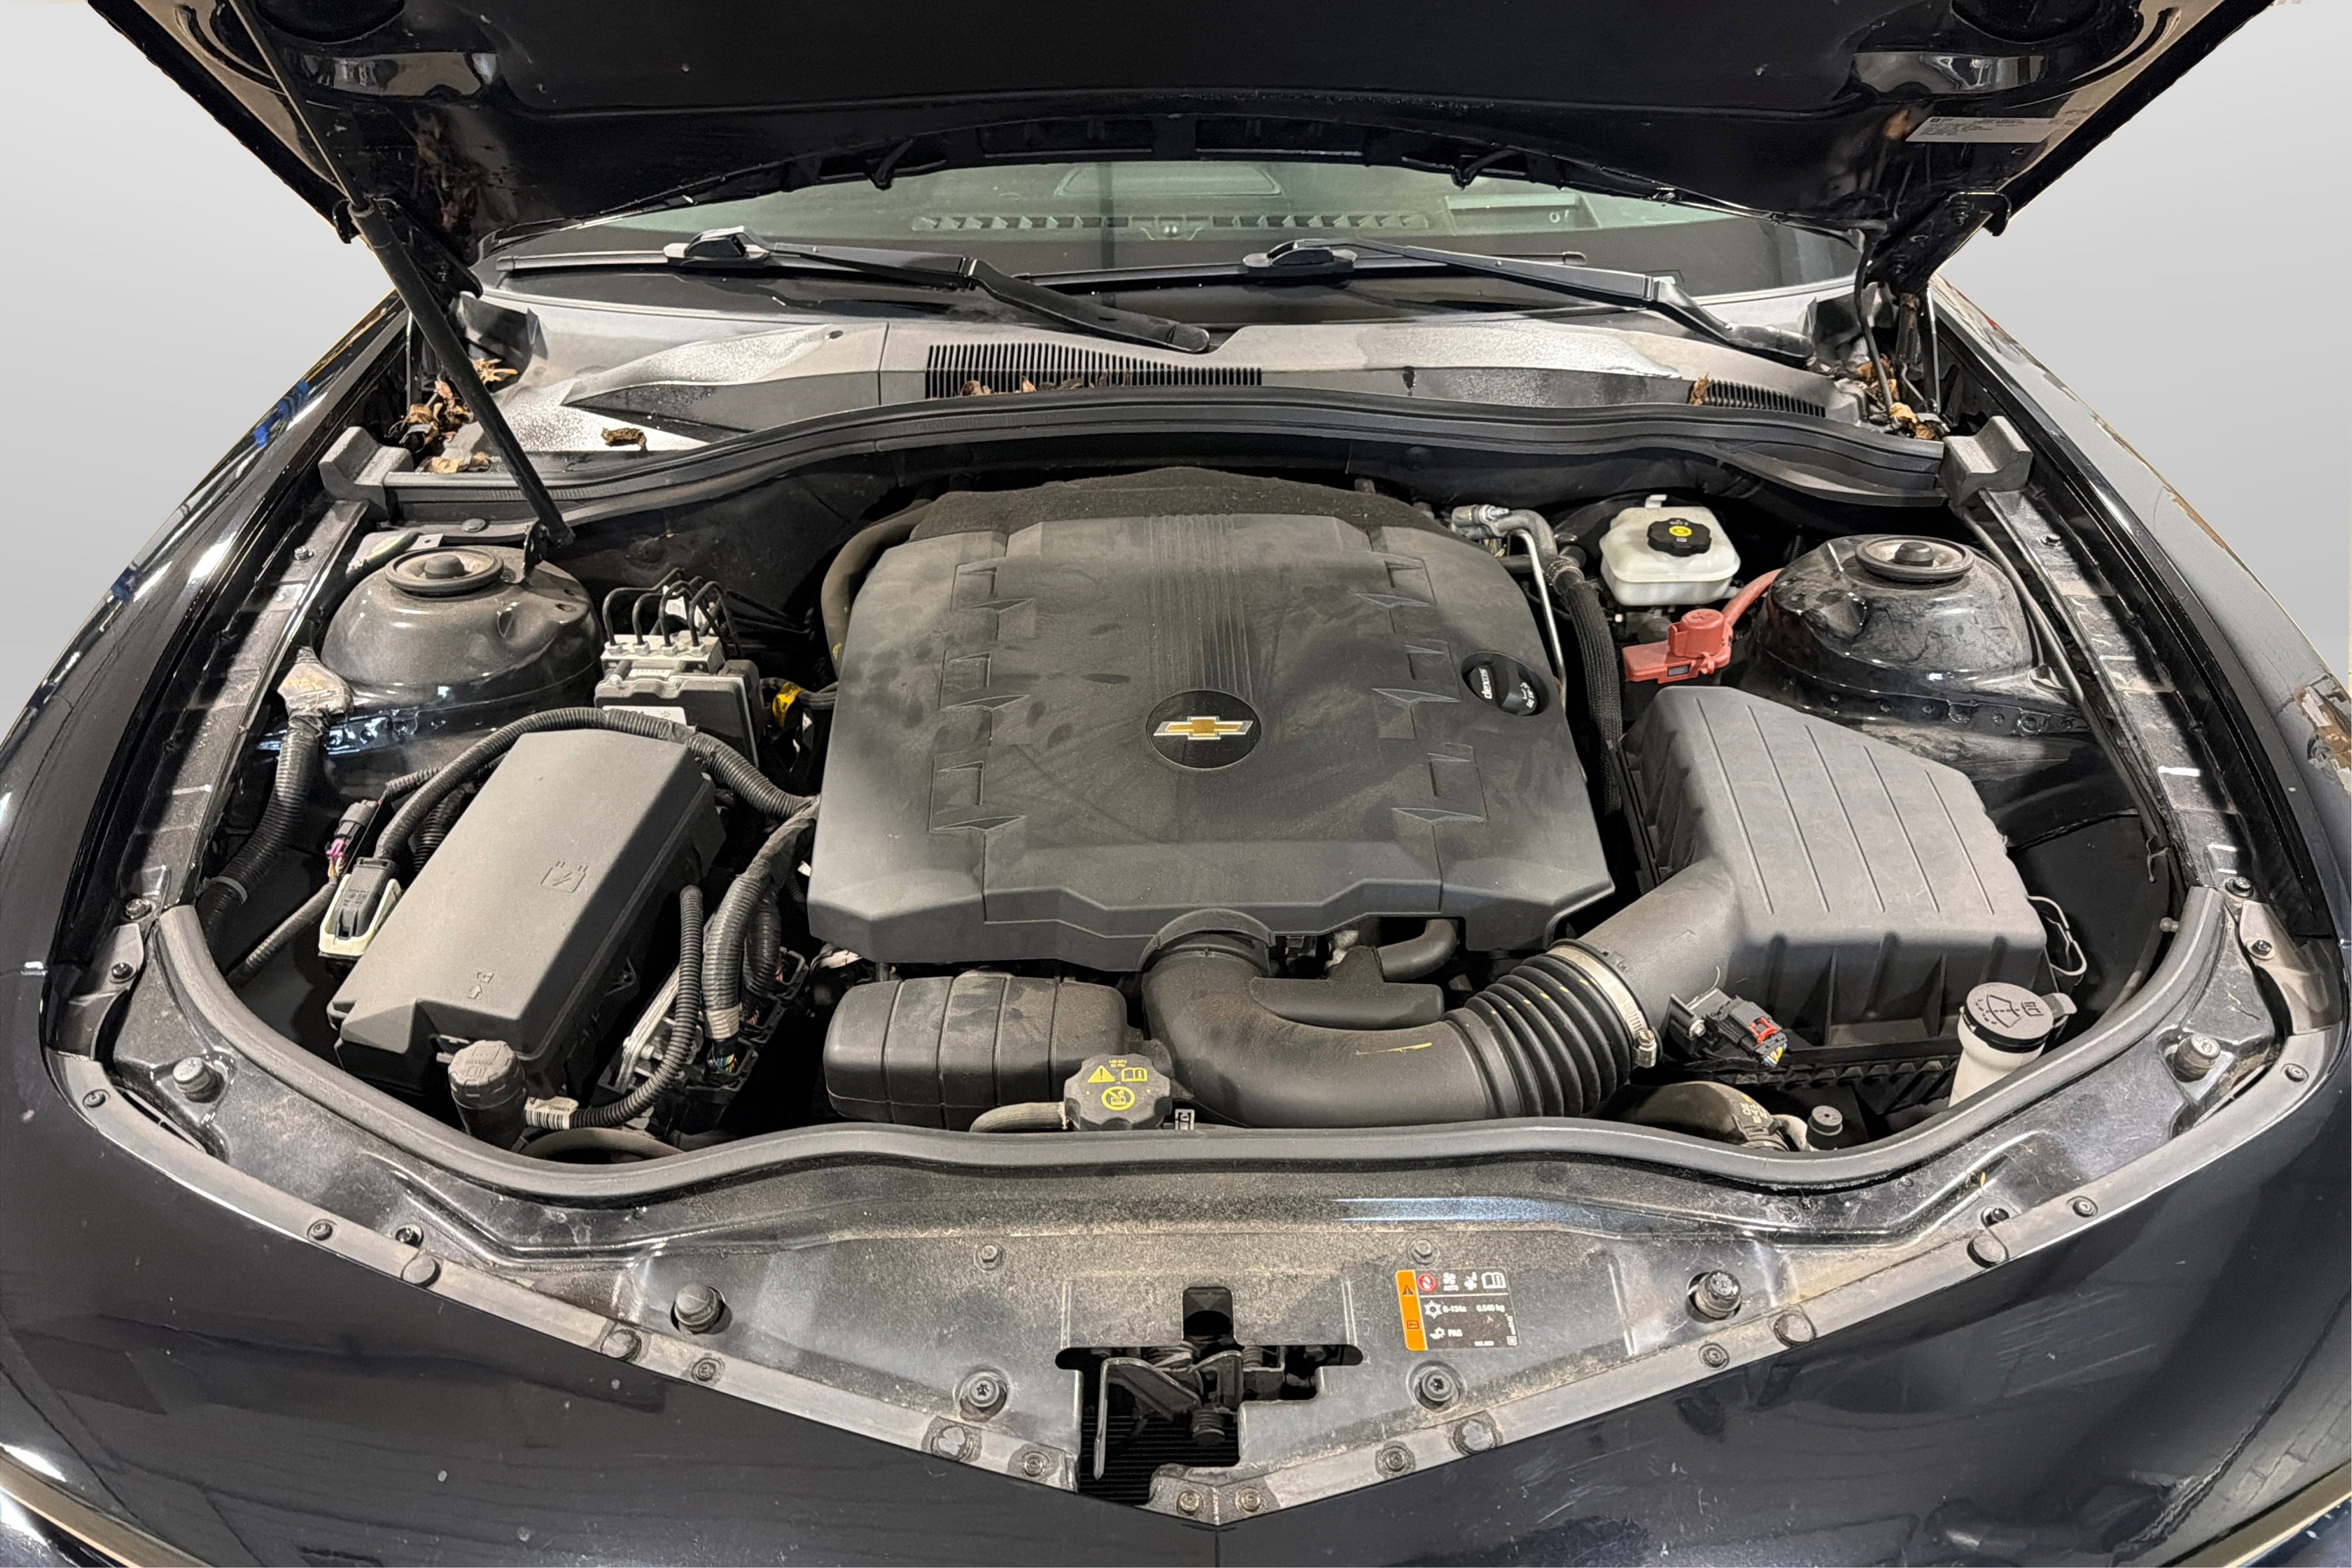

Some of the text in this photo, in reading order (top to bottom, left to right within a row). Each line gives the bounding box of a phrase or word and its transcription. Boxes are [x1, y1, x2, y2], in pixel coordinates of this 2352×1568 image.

[1479, 667, 1492, 699] dexos
[1495, 1303, 1505, 1313] kg
[1448, 1329, 1463, 1337] PAG
